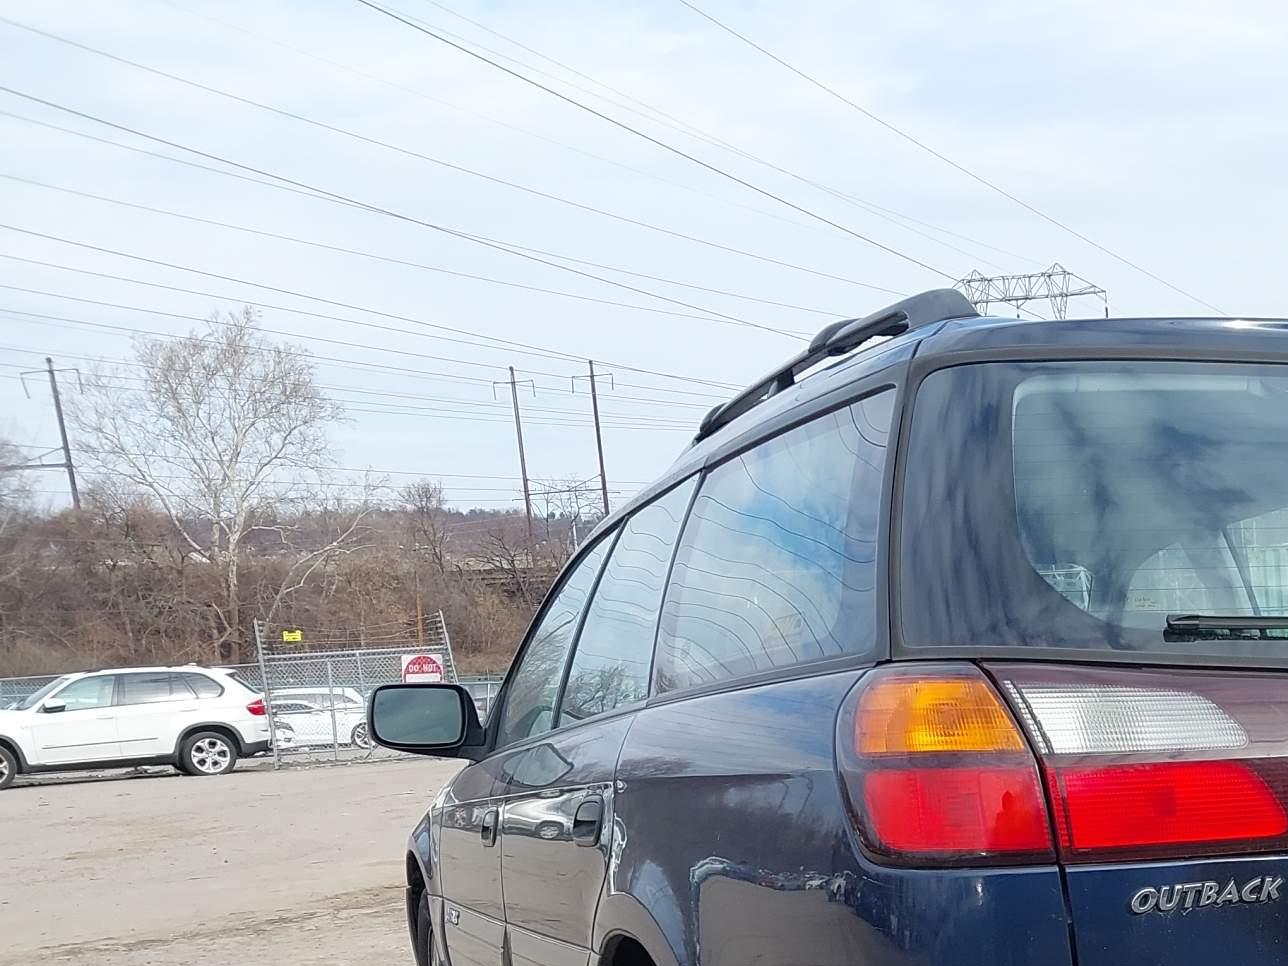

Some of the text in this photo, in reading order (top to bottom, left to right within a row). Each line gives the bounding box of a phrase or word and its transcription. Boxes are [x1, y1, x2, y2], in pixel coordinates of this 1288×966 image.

[408, 663, 437, 672] DO NOT
[1130, 876, 1284, 914] OUTBACK
